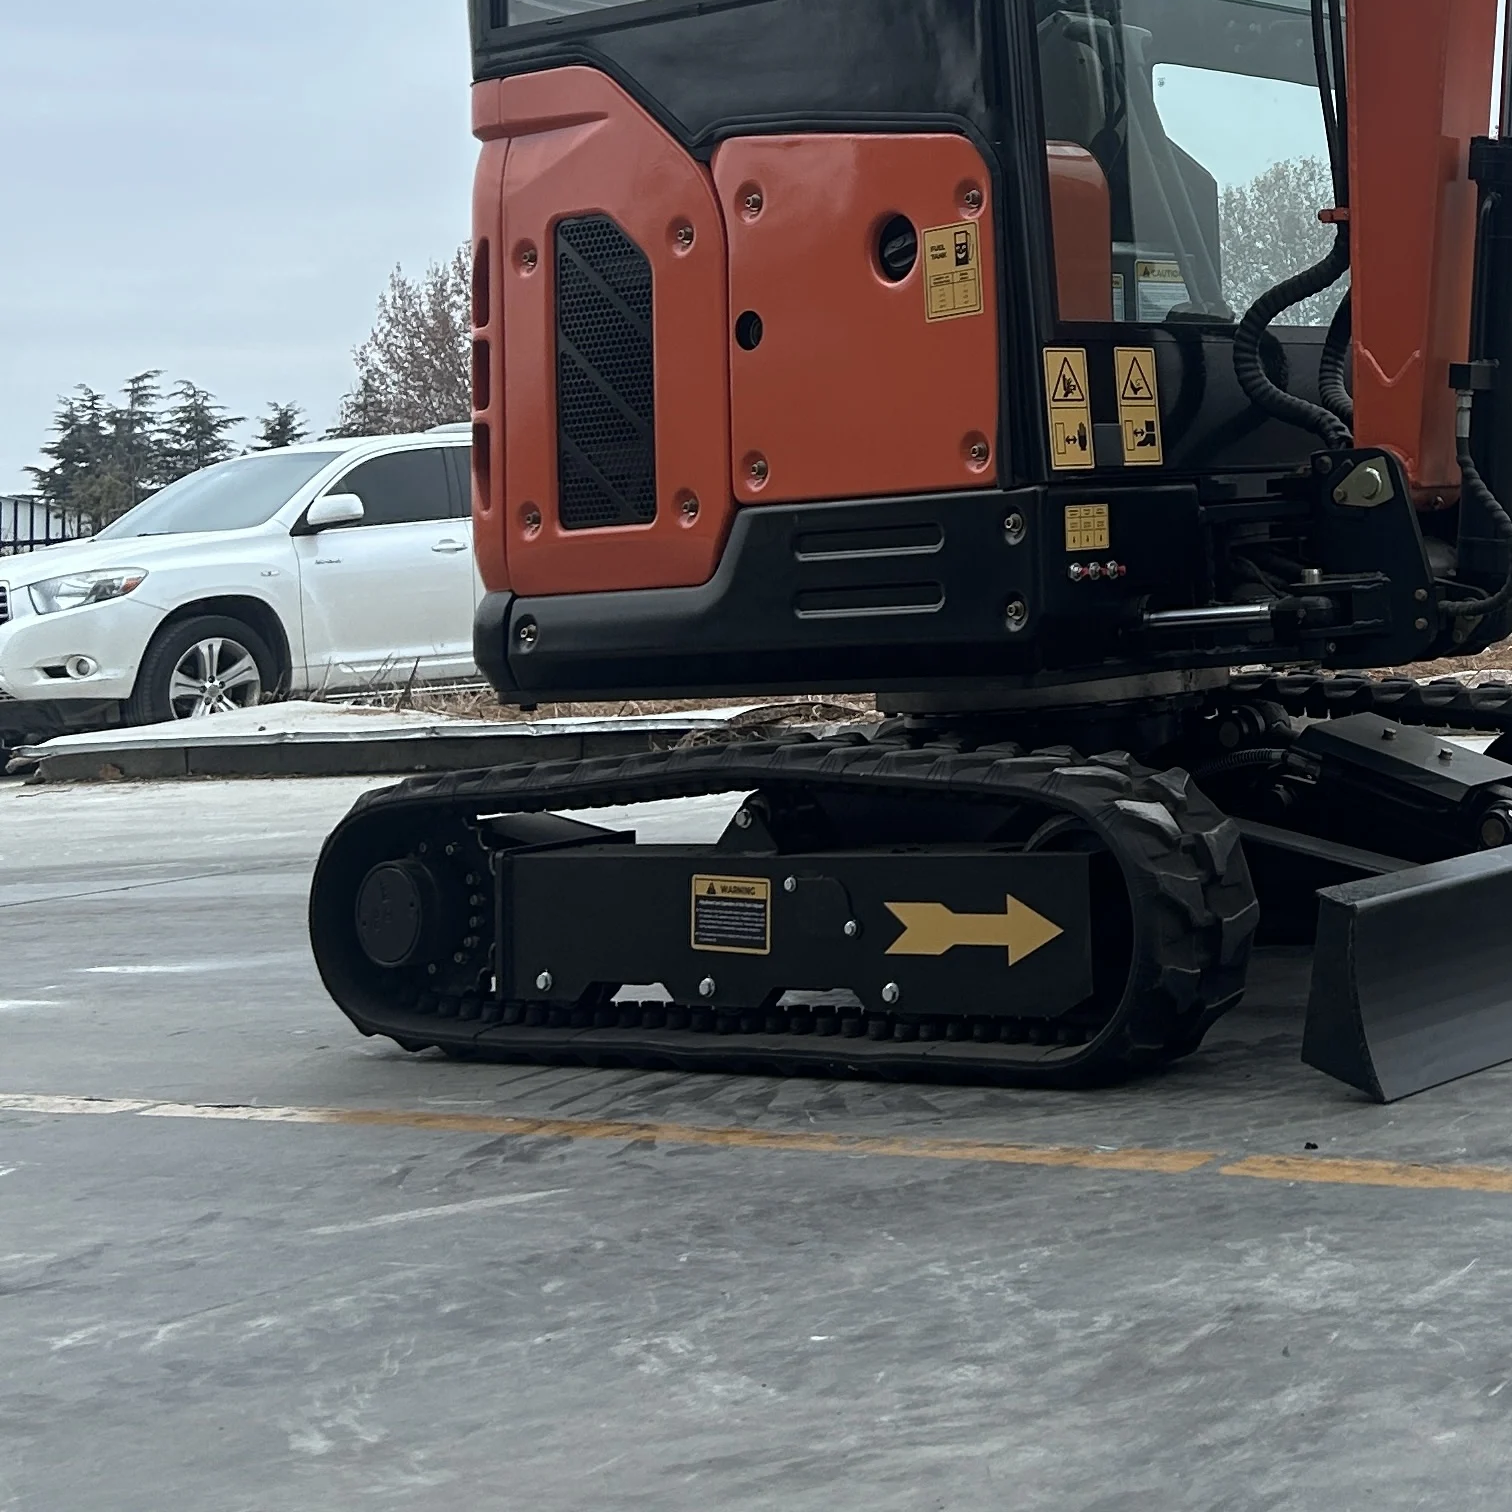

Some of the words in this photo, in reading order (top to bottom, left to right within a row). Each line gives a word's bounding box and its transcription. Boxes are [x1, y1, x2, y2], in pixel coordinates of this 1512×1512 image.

[930, 244, 945, 252] FUEL
[930, 252, 947, 260] TANK
[720, 885, 756, 896] WARNING
